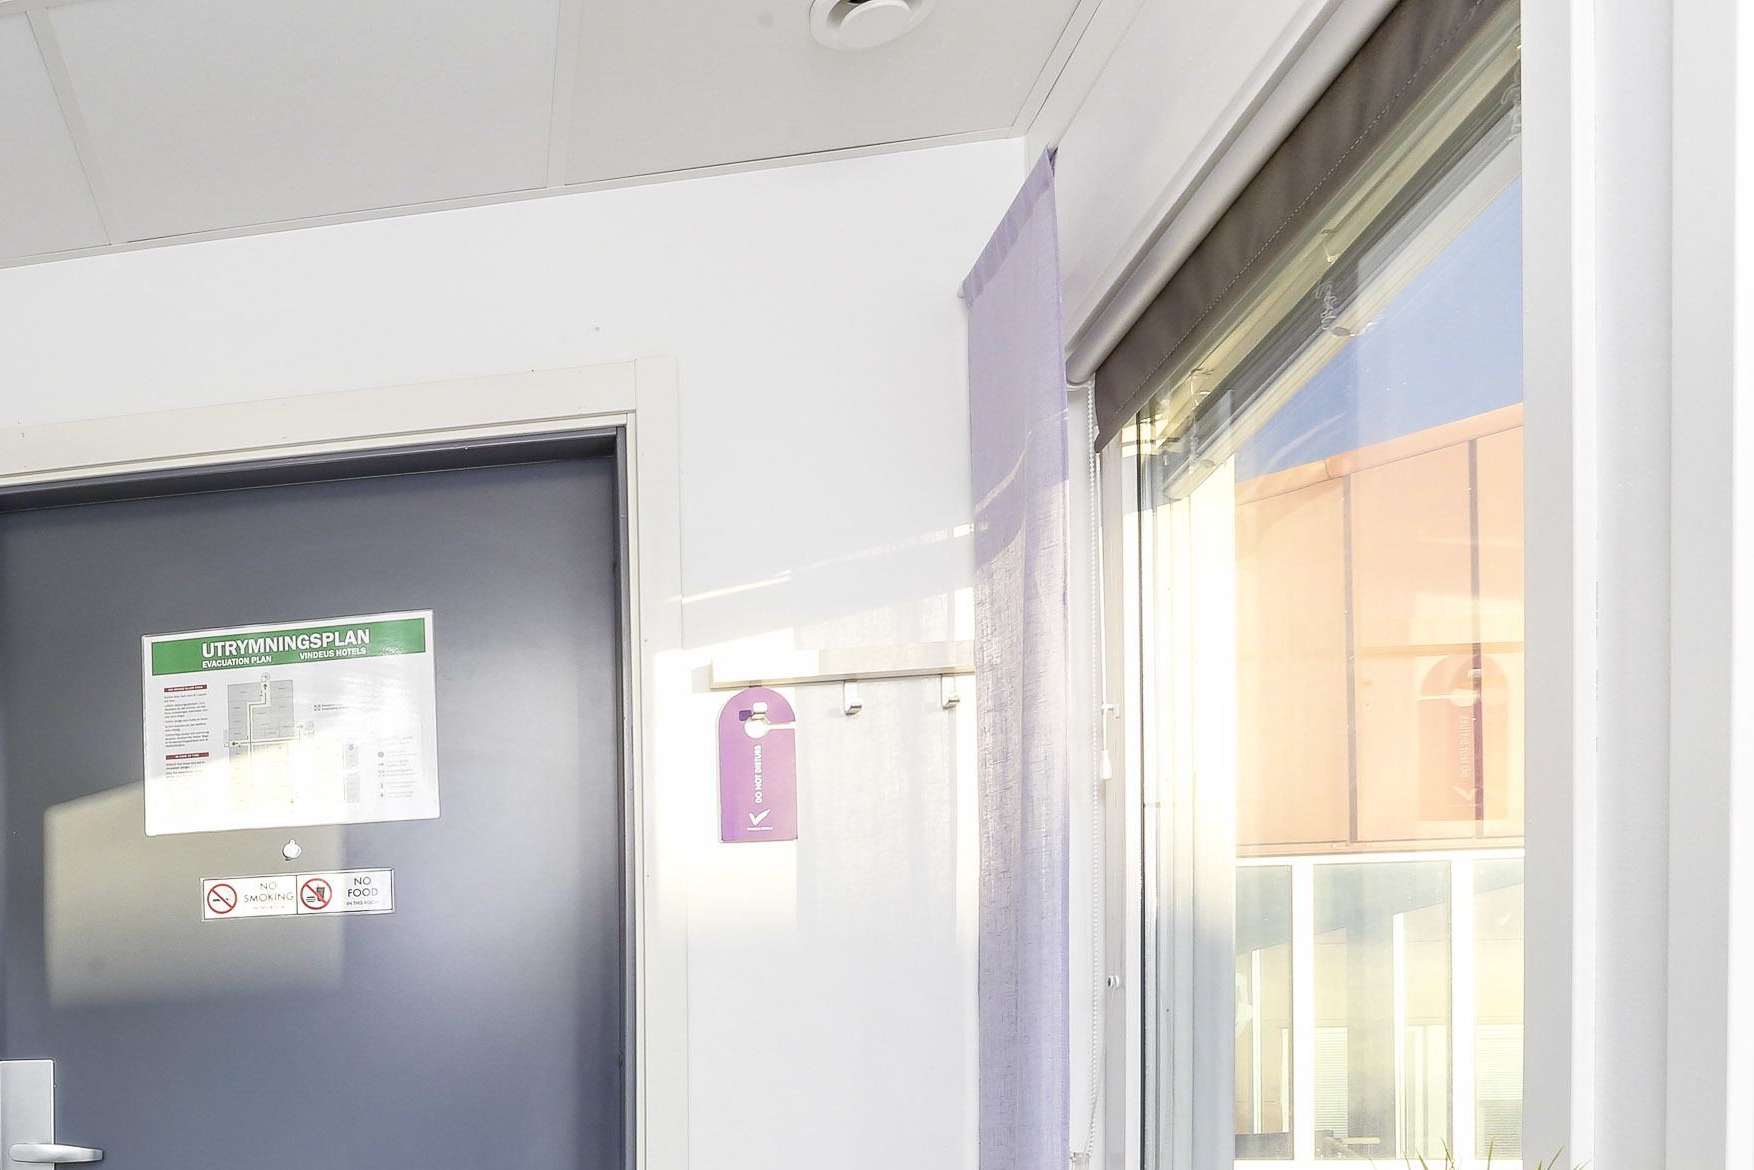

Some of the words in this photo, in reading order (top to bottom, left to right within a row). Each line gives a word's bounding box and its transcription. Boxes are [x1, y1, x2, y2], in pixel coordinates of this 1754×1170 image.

[202, 628, 370, 658] UTRYMNINGSPLAN
[299, 650, 334, 660] VINDEUS
[336, 647, 367, 657] HOTELS
[202, 657, 250, 669] EVACUATION
[251, 655, 272, 664] PLAN
[754, 791, 763, 804] DO
[260, 882, 277, 891] NO
[353, 876, 372, 886] NO
[347, 887, 379, 897] FOOD
[244, 893, 294, 903] SMOKING
